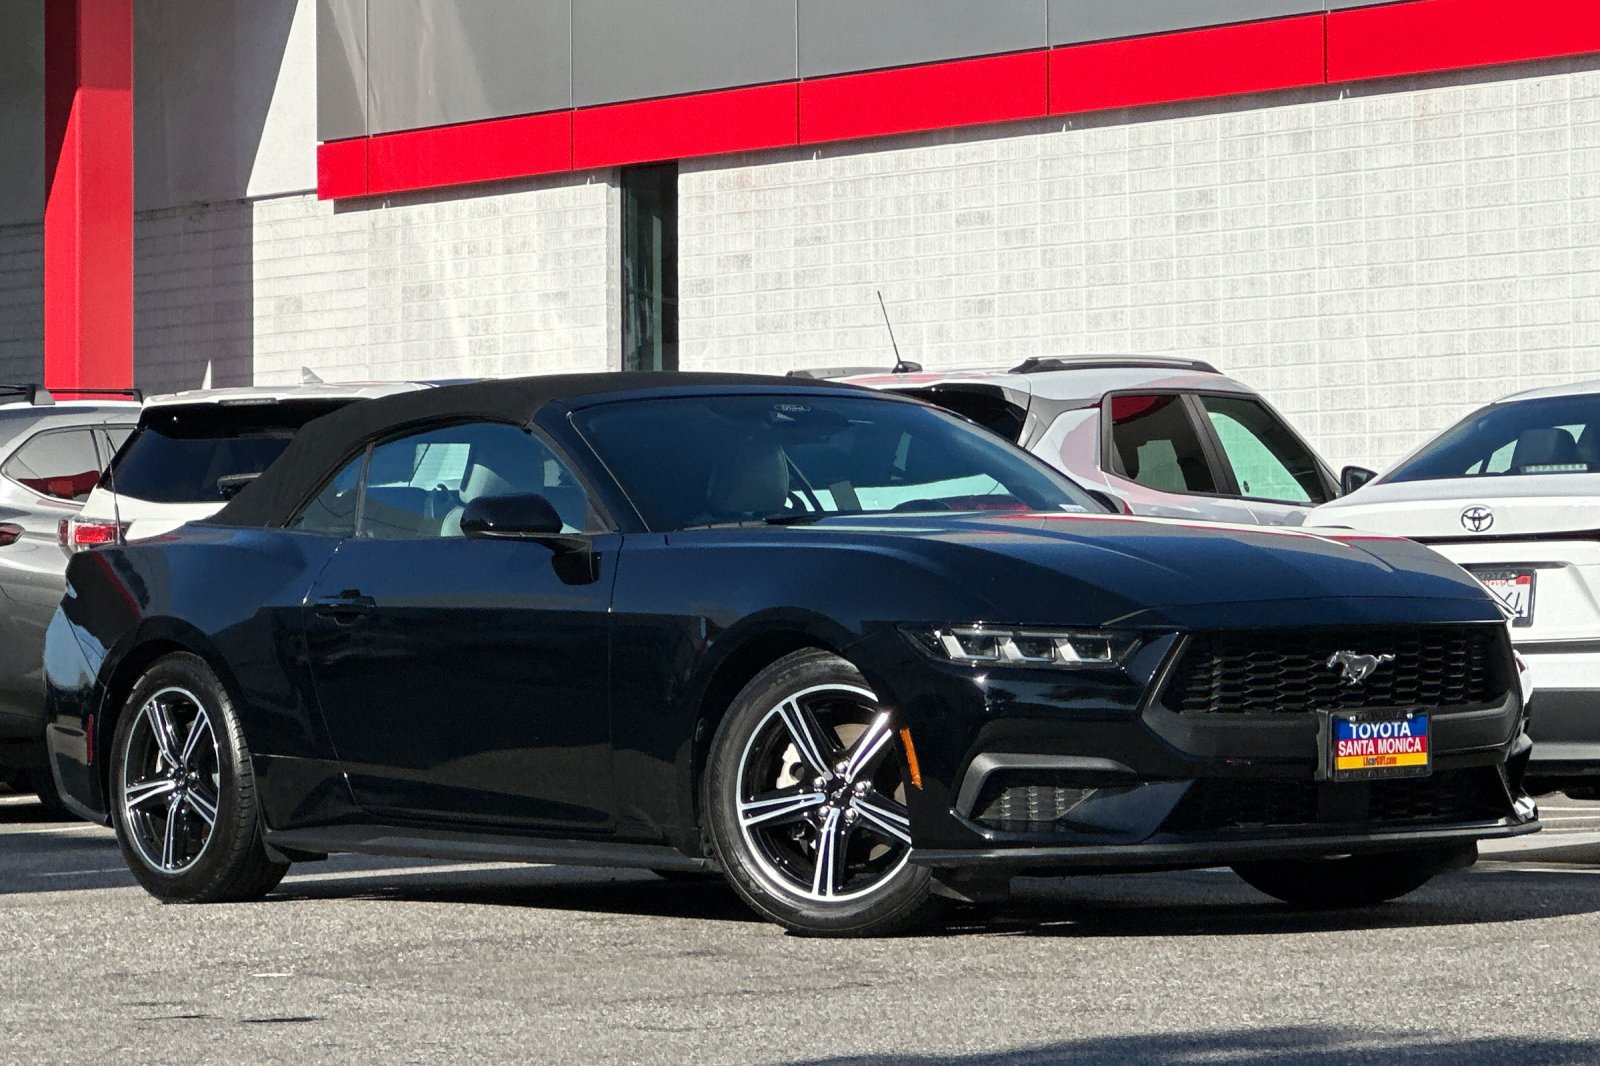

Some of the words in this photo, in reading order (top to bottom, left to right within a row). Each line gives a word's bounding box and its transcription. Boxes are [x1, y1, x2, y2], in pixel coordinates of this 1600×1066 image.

[1349, 721, 1411, 739] TOYOTA
[1338, 739, 1375, 757] SANTA
[1378, 737, 1422, 754] MONICA
